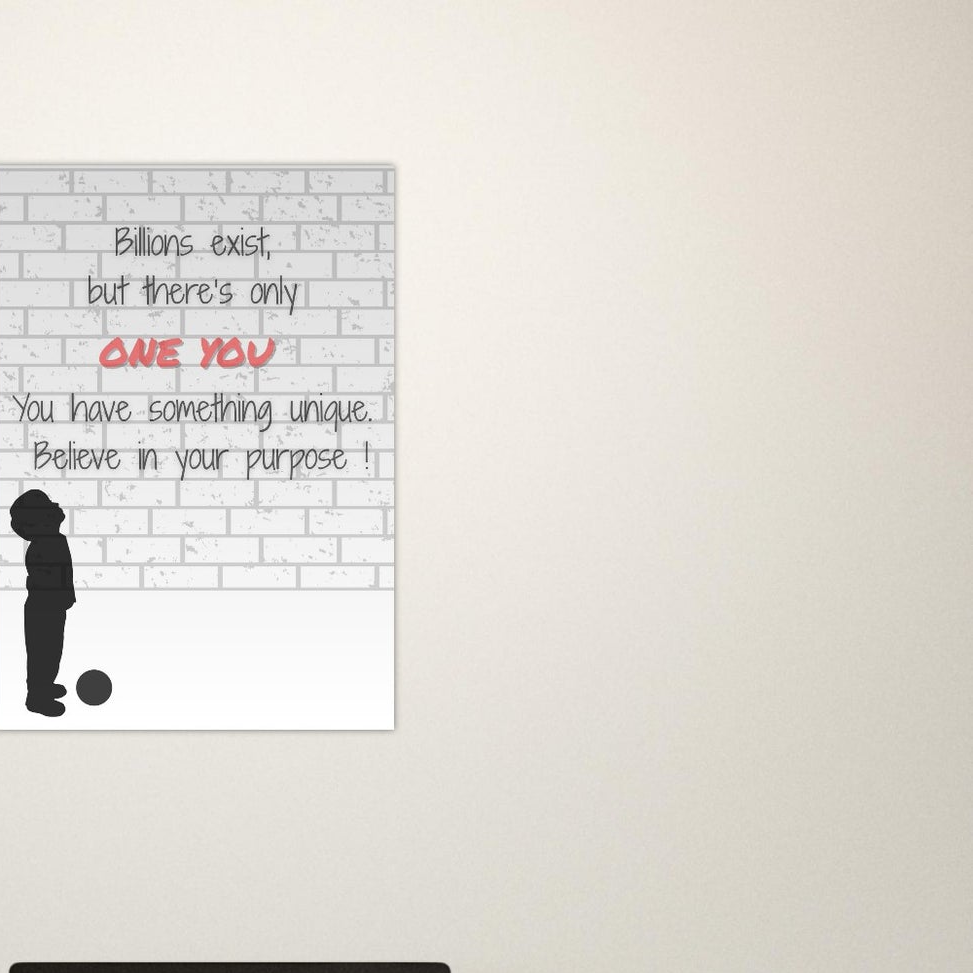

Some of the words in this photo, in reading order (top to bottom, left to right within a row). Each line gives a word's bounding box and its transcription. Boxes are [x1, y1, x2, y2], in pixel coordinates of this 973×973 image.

[115, 226, 194, 256] Billions
[211, 227, 271, 260] exist,
[87, 275, 129, 305] but
[143, 275, 233, 305] there's
[250, 275, 297, 315] only
[99, 337, 183, 368] ONE
[200, 337, 276, 369] YOU
[13, 393, 54, 422] You
[71, 393, 131, 422] have
[149, 393, 272, 432] something
[290, 394, 372, 432] unique.
[34, 441, 121, 470] Believe
[139, 441, 157, 470] in
[175, 447, 229, 480] your
[247, 447, 347, 480] purpose
